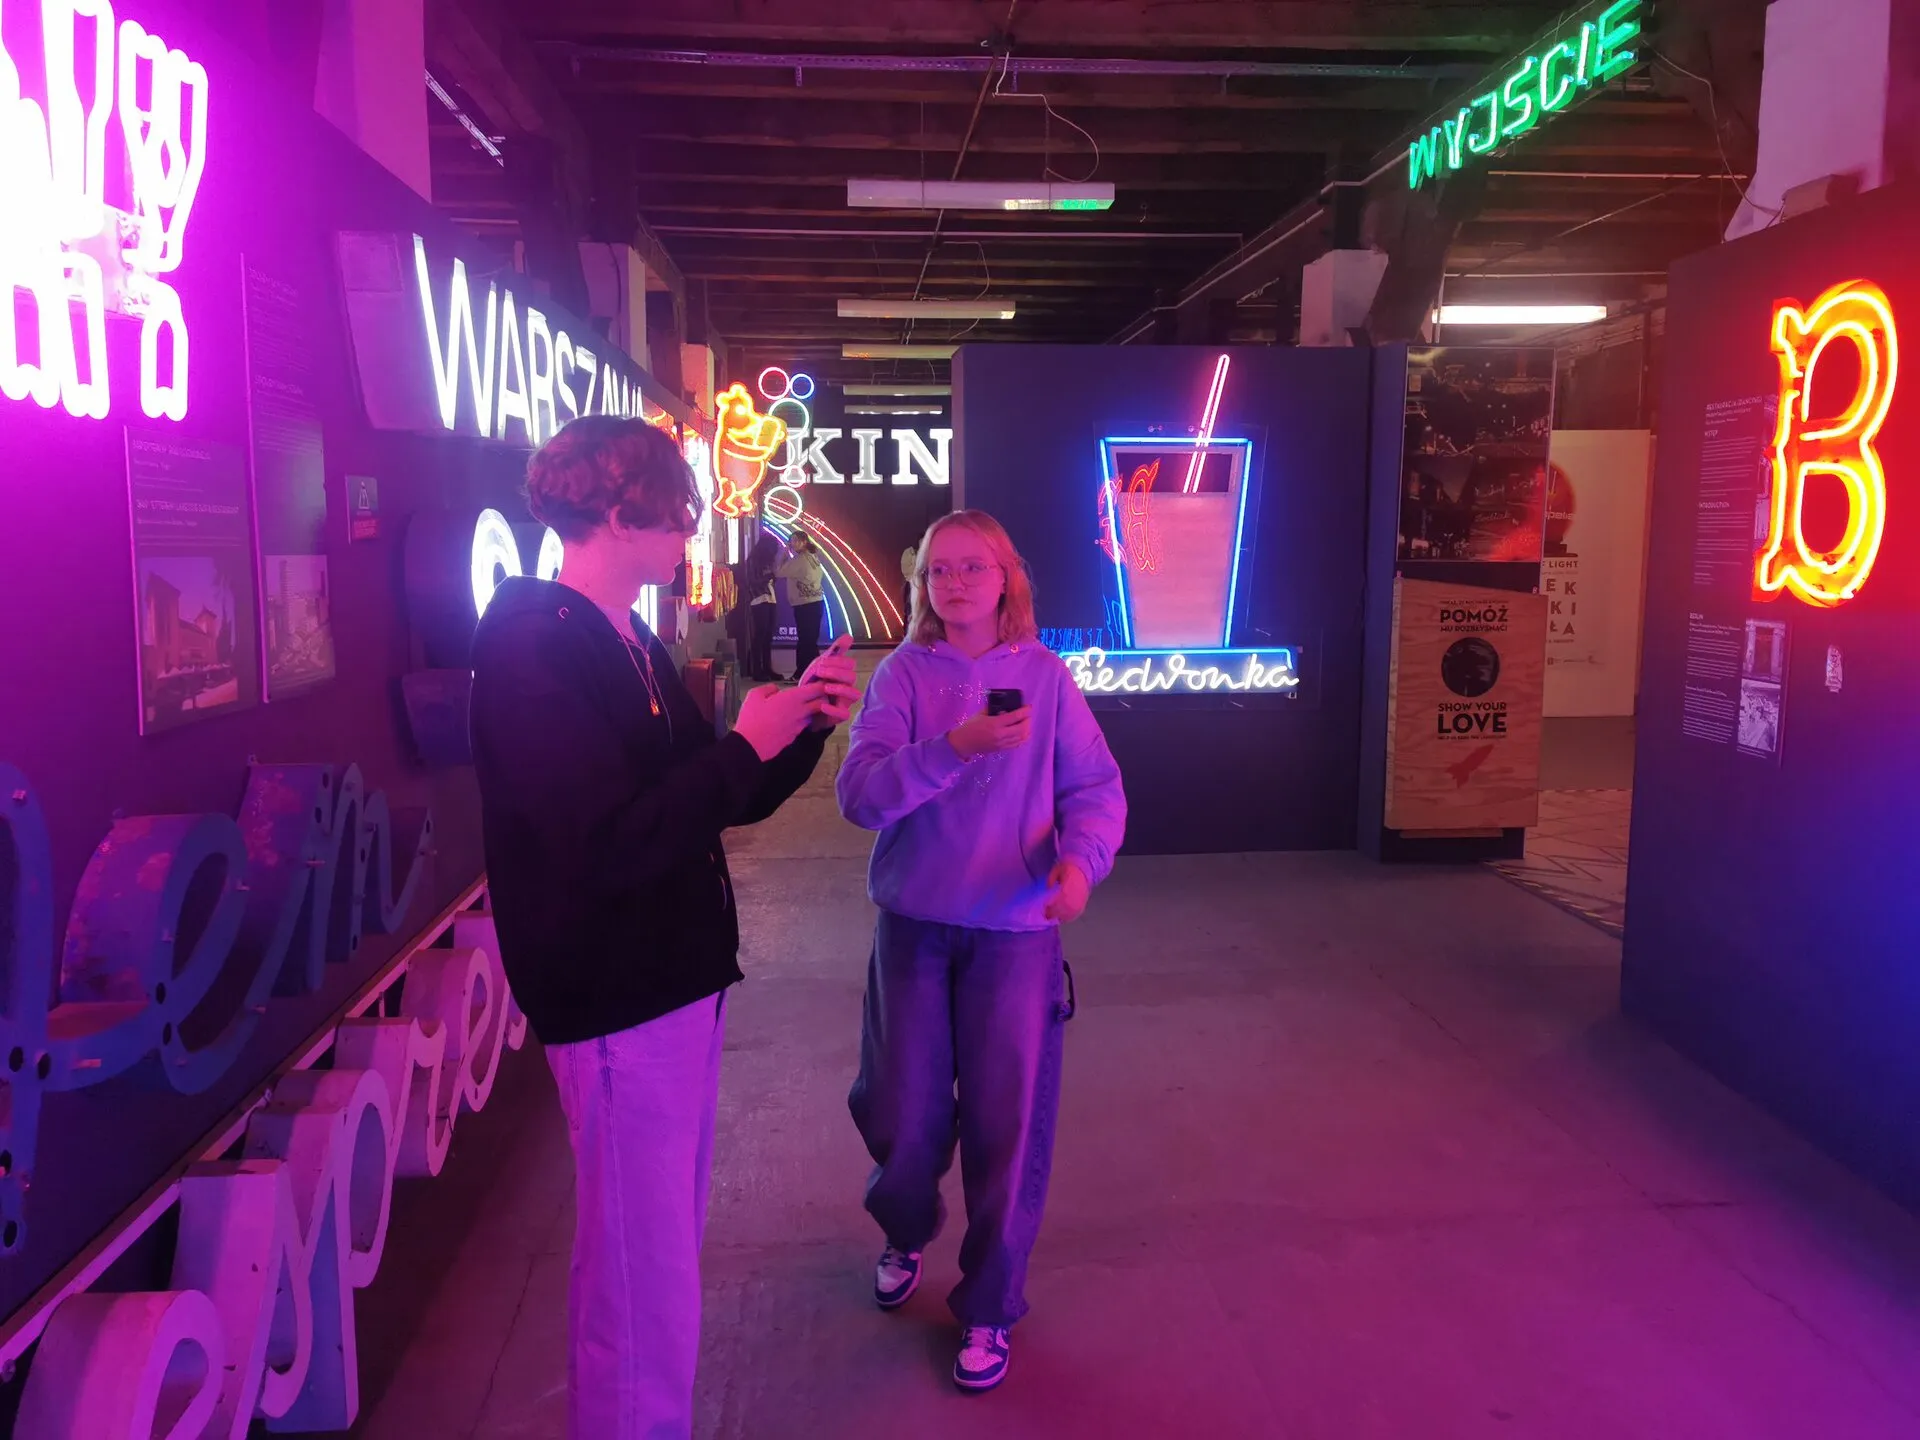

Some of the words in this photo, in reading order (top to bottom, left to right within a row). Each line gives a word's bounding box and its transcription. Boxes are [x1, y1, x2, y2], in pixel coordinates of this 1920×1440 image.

[1548, 560, 1579, 569] LIGHT
[1438, 702, 1472, 713] SHOW
[1475, 701, 1508, 712] YOUR
[1437, 711, 1508, 734] LOVE
